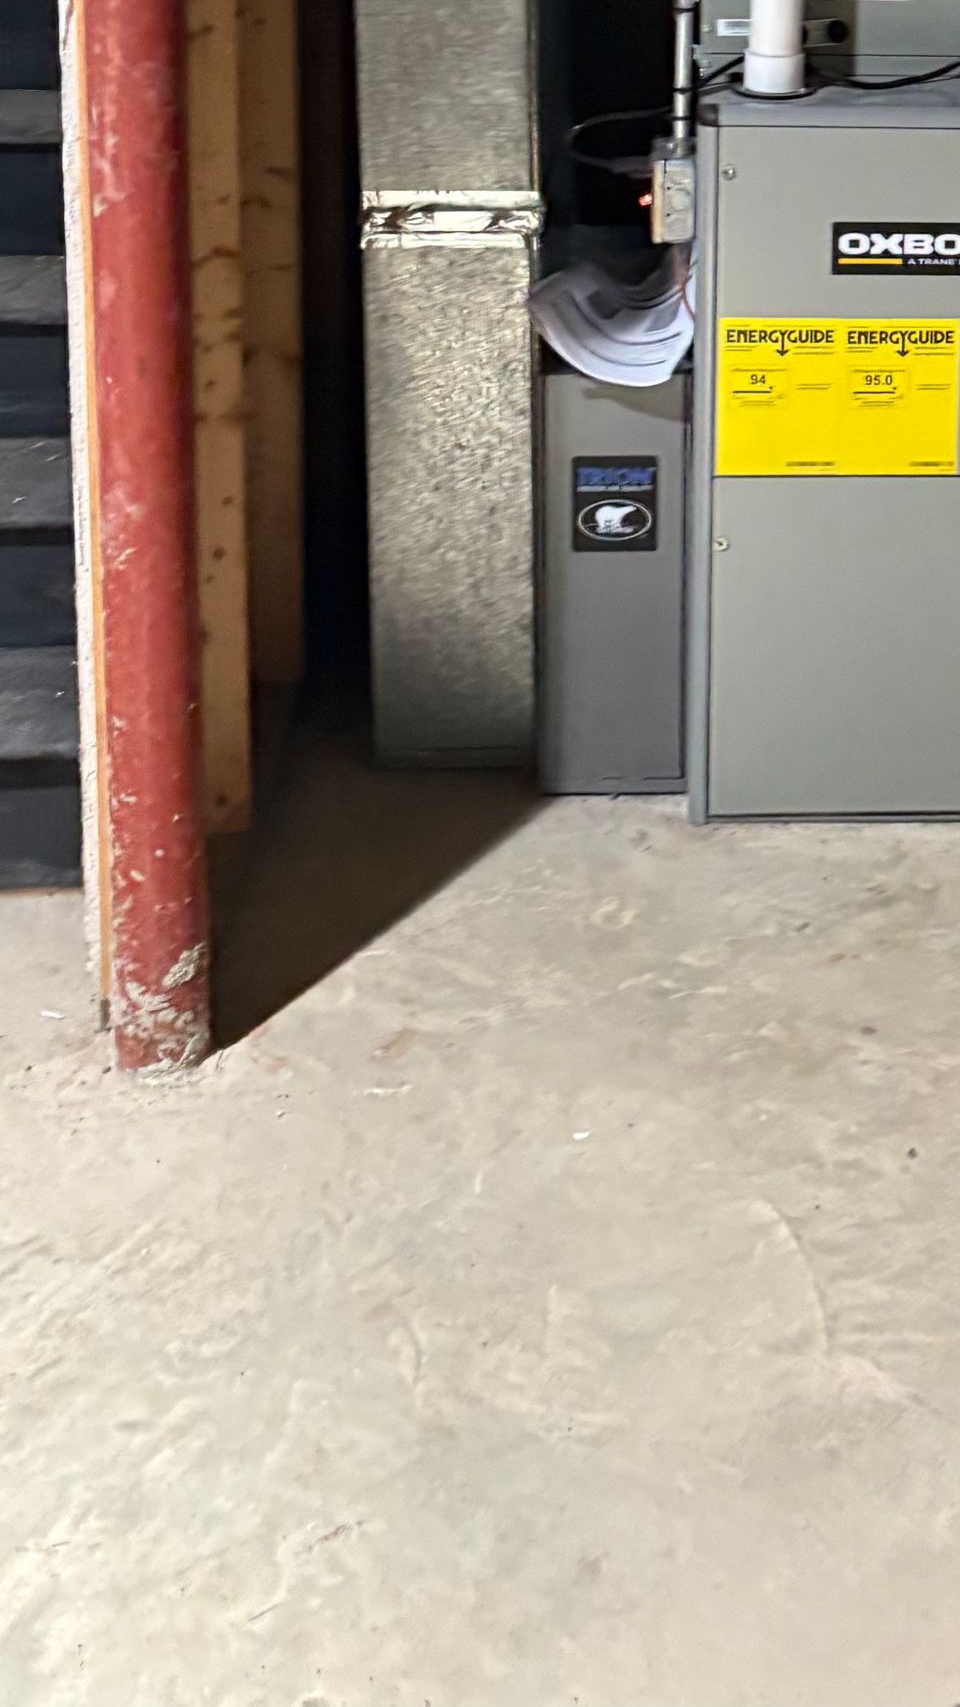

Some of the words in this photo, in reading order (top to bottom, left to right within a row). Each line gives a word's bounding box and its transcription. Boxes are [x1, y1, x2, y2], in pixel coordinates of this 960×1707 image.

[907, 258, 916, 266] A
[919, 258, 955, 266] TRANE
[726, 329, 834, 350] ENERGYGUIDE
[847, 330, 955, 351] ENERGYGUIDE
[750, 374, 766, 385] 94
[865, 375, 893, 386] 95.0
